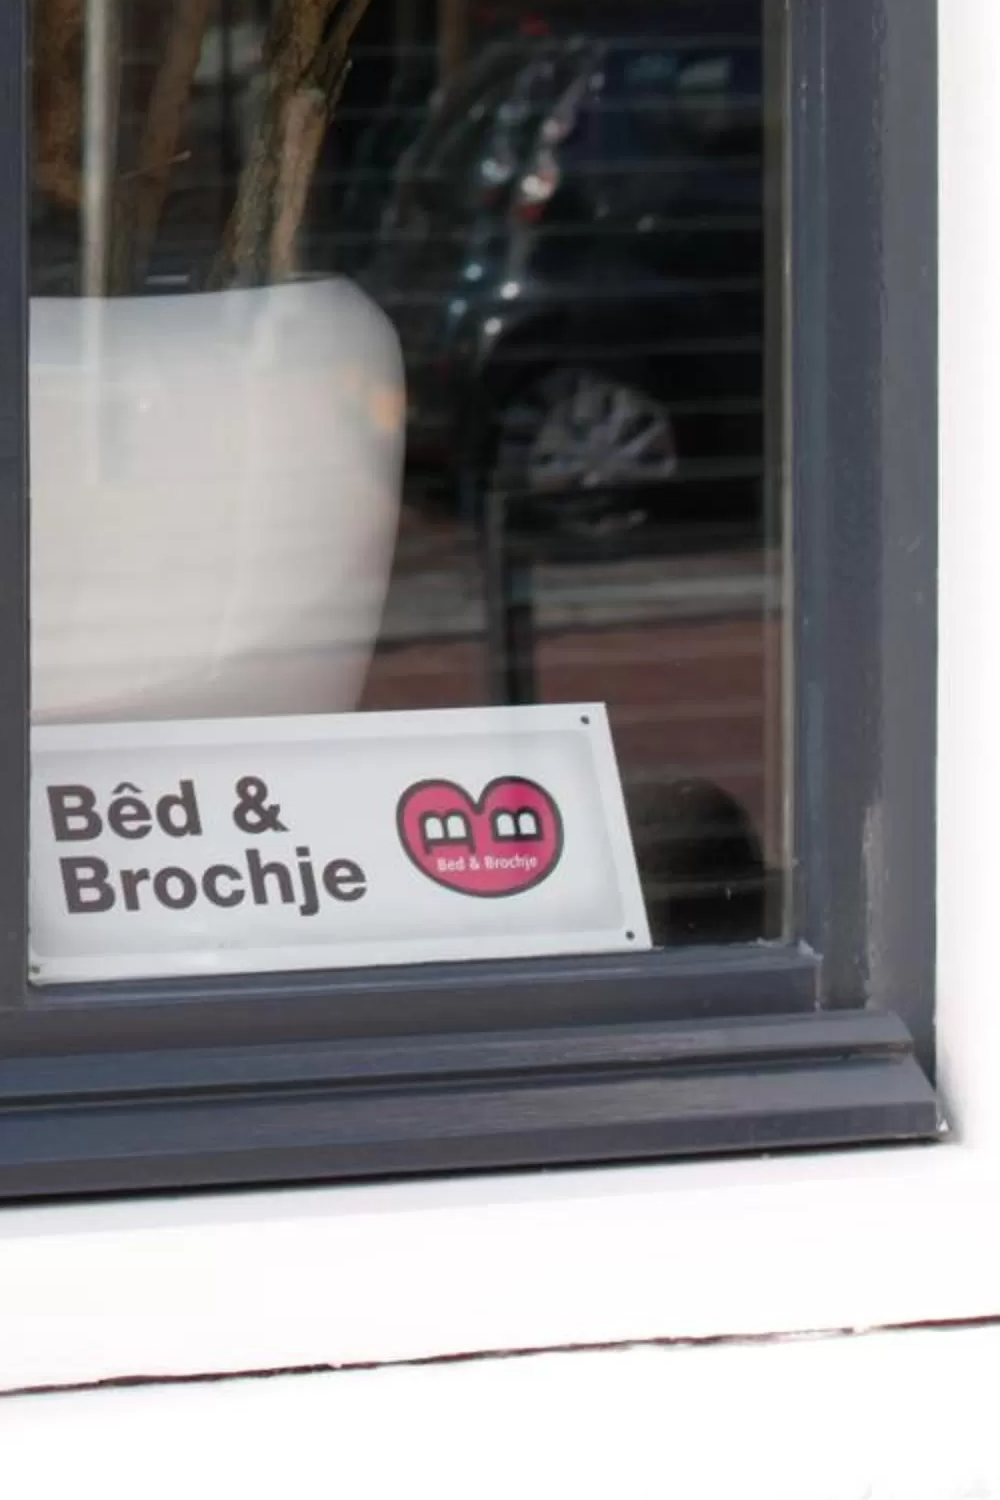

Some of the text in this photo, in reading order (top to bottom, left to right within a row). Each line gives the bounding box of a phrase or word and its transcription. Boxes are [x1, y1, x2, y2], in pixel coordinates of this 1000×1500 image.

[47, 776, 289, 842] Bêd &
[59, 846, 367, 916] Brochje
[469, 855, 481, 870] &
[483, 853, 538, 871] Brochje
